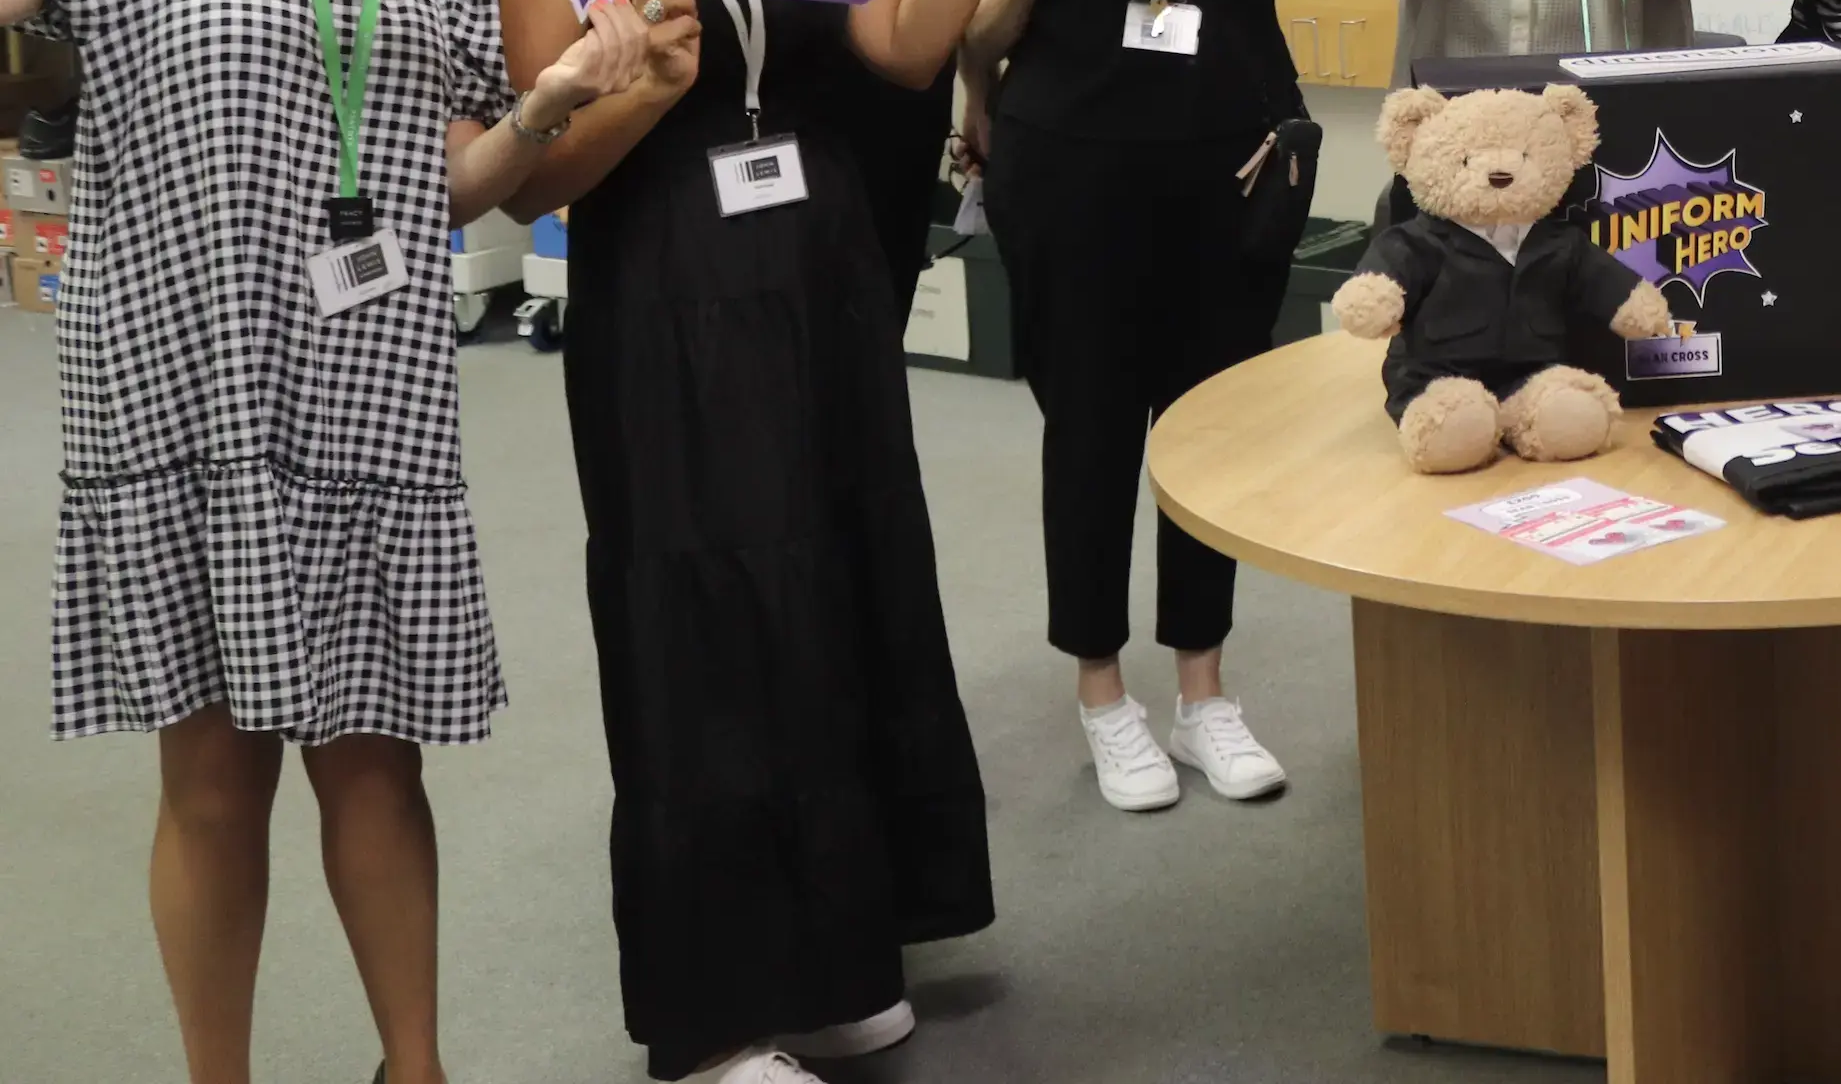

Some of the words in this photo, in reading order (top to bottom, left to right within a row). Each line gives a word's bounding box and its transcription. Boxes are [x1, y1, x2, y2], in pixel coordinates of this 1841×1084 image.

[1571, 42, 1818, 66] dimensions
[1590, 191, 1765, 256] UNIFORM
[1675, 225, 1752, 275] HERO
[1671, 349, 1710, 363] CROSS
